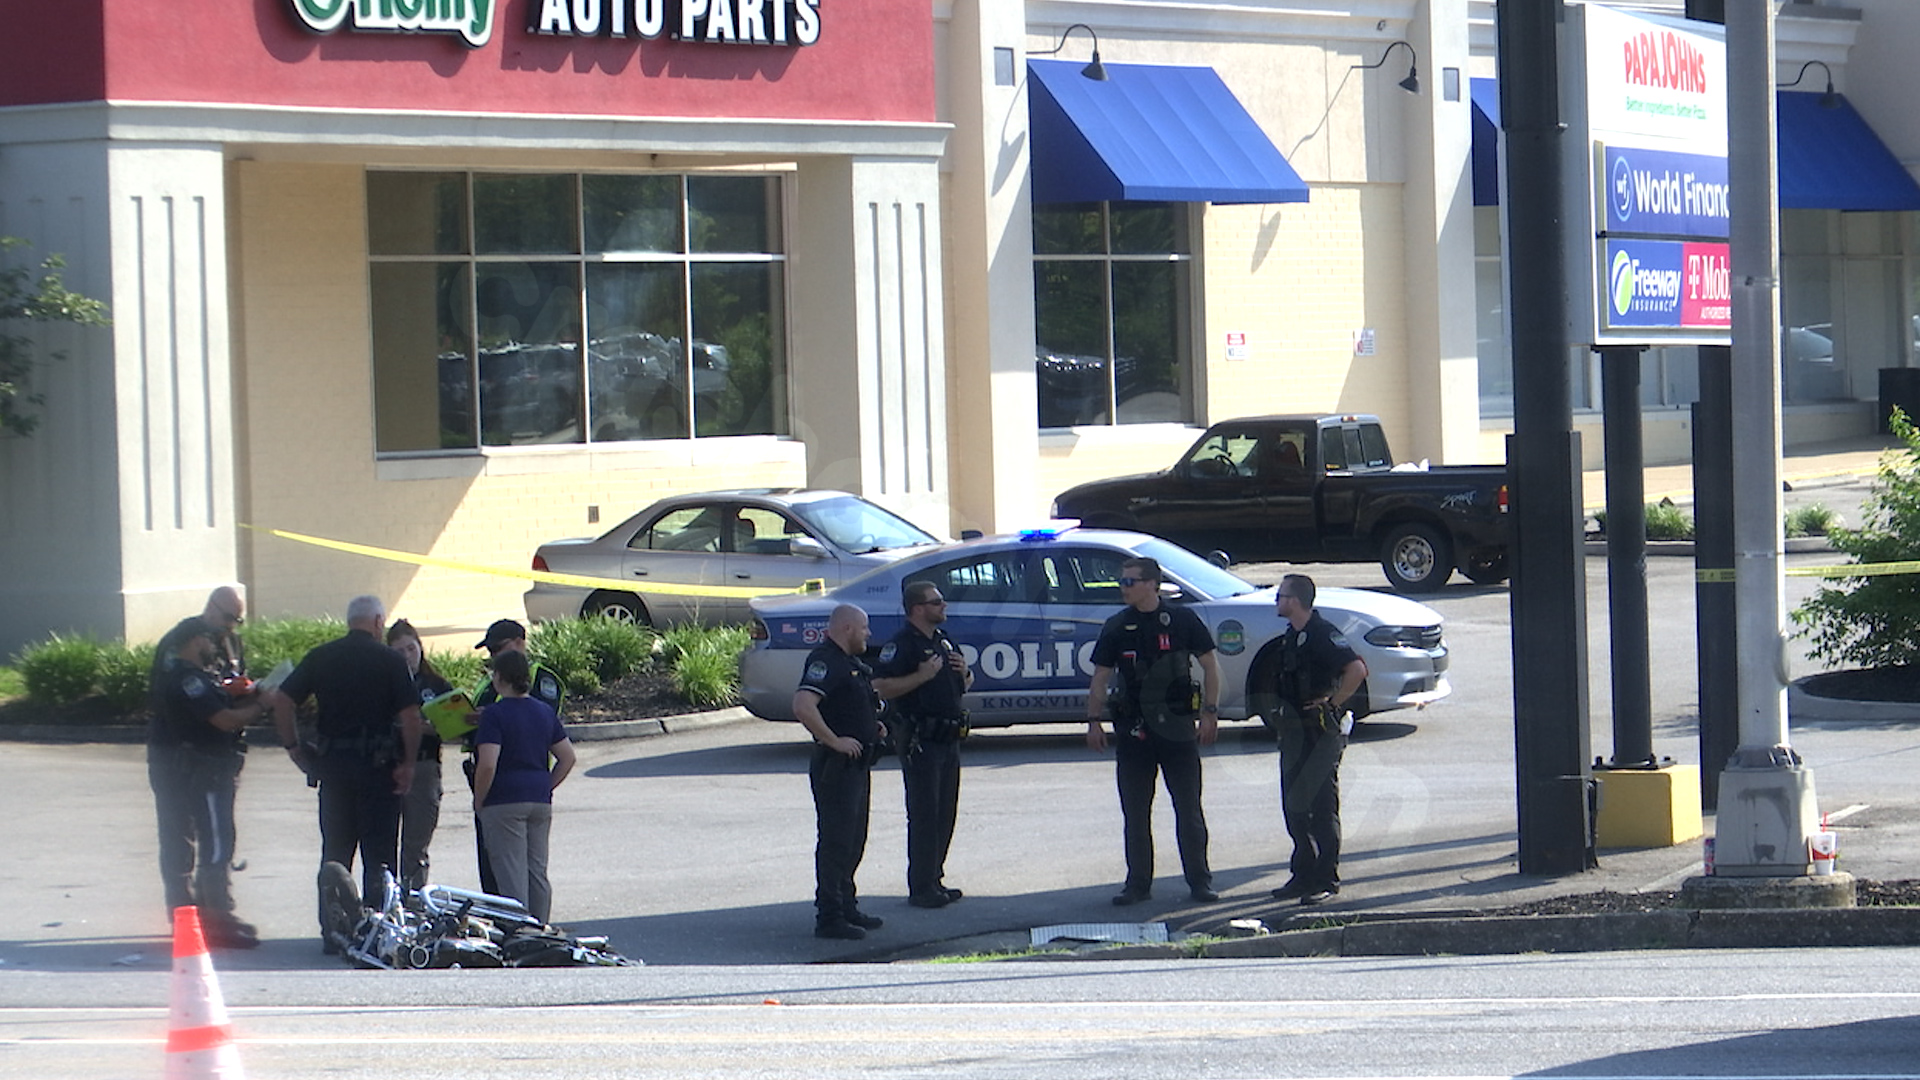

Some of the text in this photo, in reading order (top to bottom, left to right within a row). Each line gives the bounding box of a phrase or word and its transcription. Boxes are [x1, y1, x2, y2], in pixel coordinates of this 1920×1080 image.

[1624, 31, 1706, 94] PAPA JOHNS
[1633, 170, 1730, 218] World Financ
[1632, 259, 1682, 307] Freeway
[1702, 255, 1731, 301] Mob
[1631, 300, 1673, 312] INSURANCE
[802, 627, 830, 645] 91
[958, 640, 1097, 680] POLIC
[981, 694, 1086, 709] KNOXVIL
